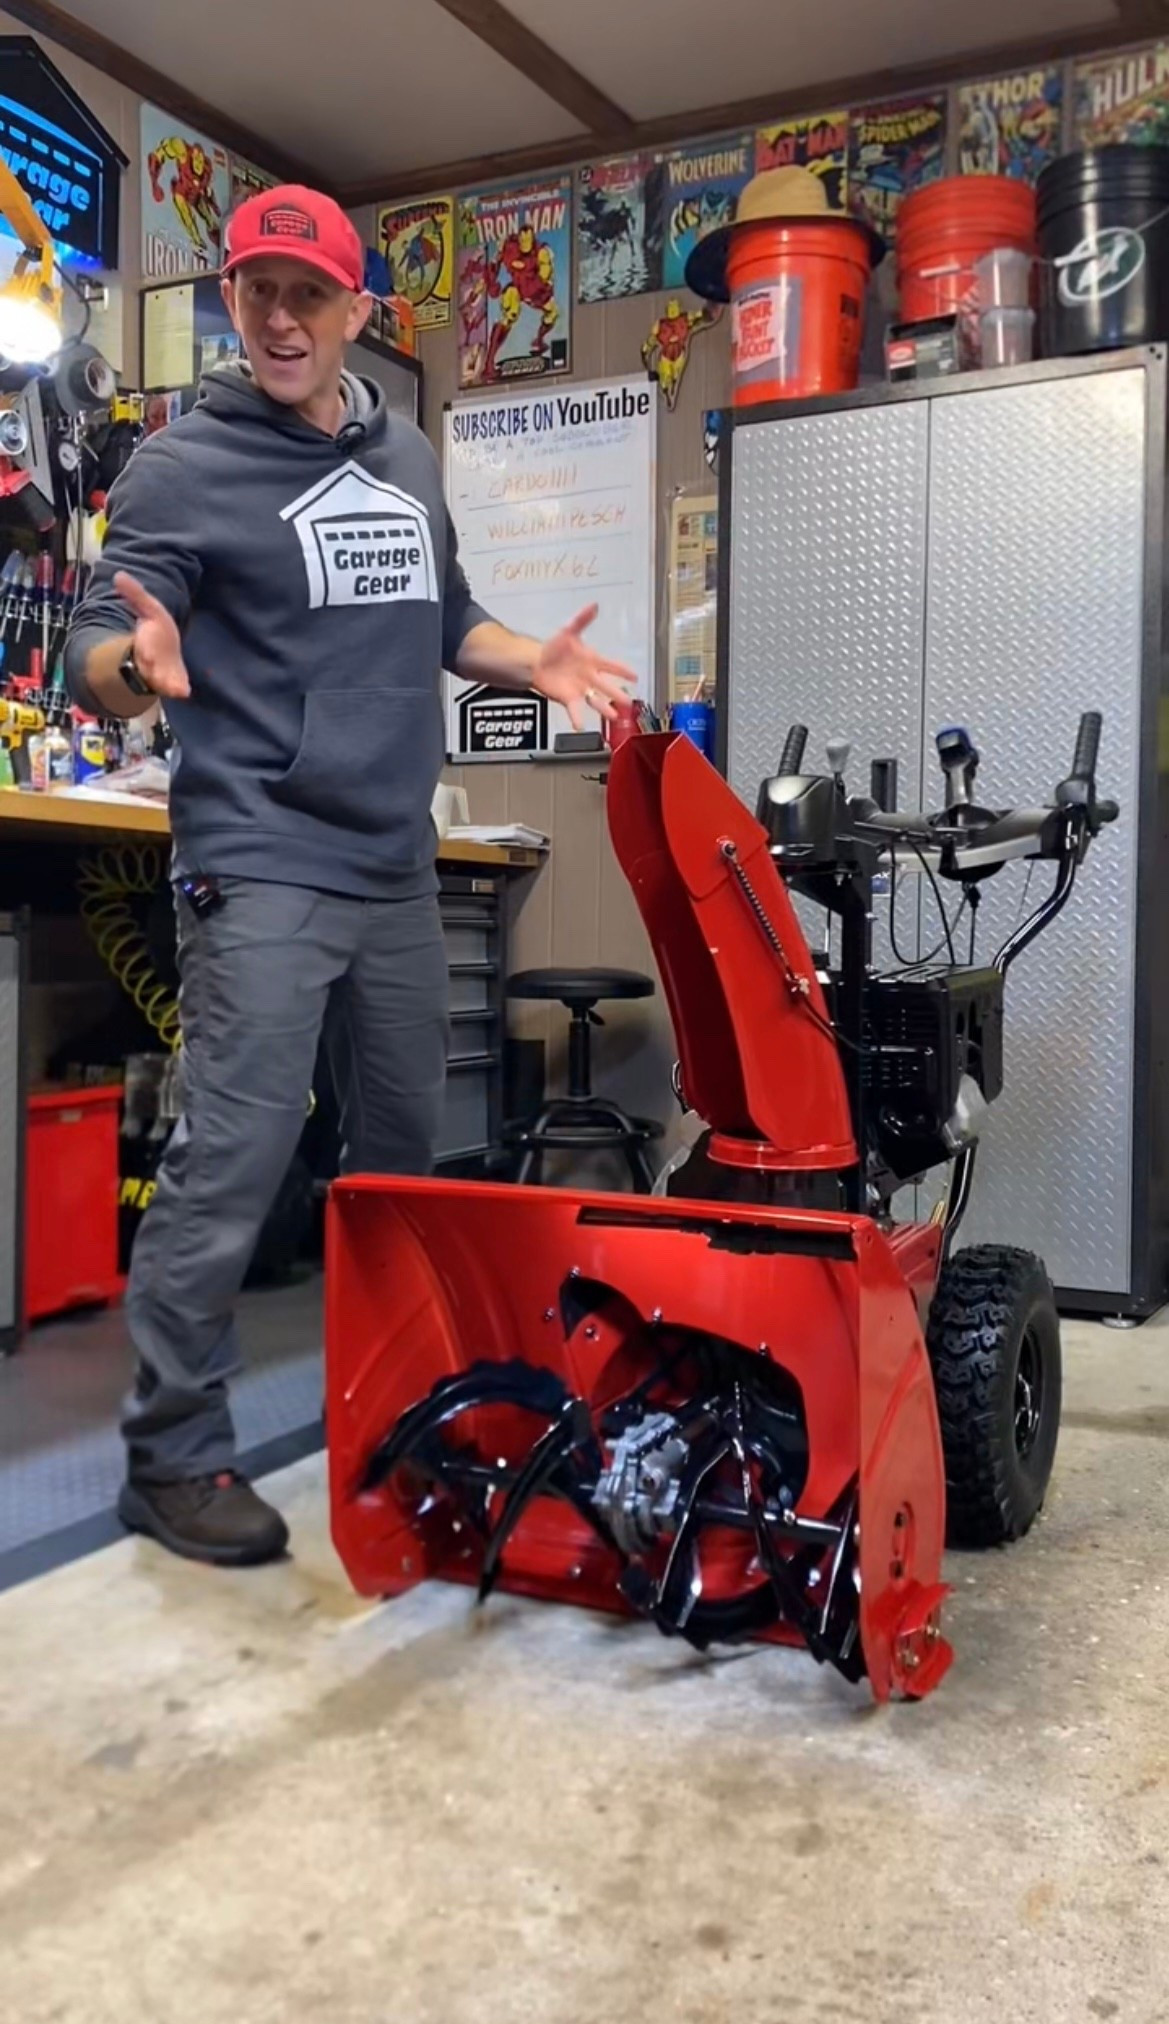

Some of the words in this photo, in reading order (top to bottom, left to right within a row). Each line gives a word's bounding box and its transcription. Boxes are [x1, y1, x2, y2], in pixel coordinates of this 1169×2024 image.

[669, 148, 747, 188] WOLVERINE
[475, 211, 519, 245] IRON
[524, 202, 566, 234] MAN
[452, 405, 529, 443] SUBSCRIBE
[533, 402, 554, 432] ON
[557, 387, 650, 427] YouTube
[333, 547, 420, 570] Garage
[354, 574, 411, 596] Gear
[474, 719, 534, 735] Garage
[484, 734, 524, 749] Gear
